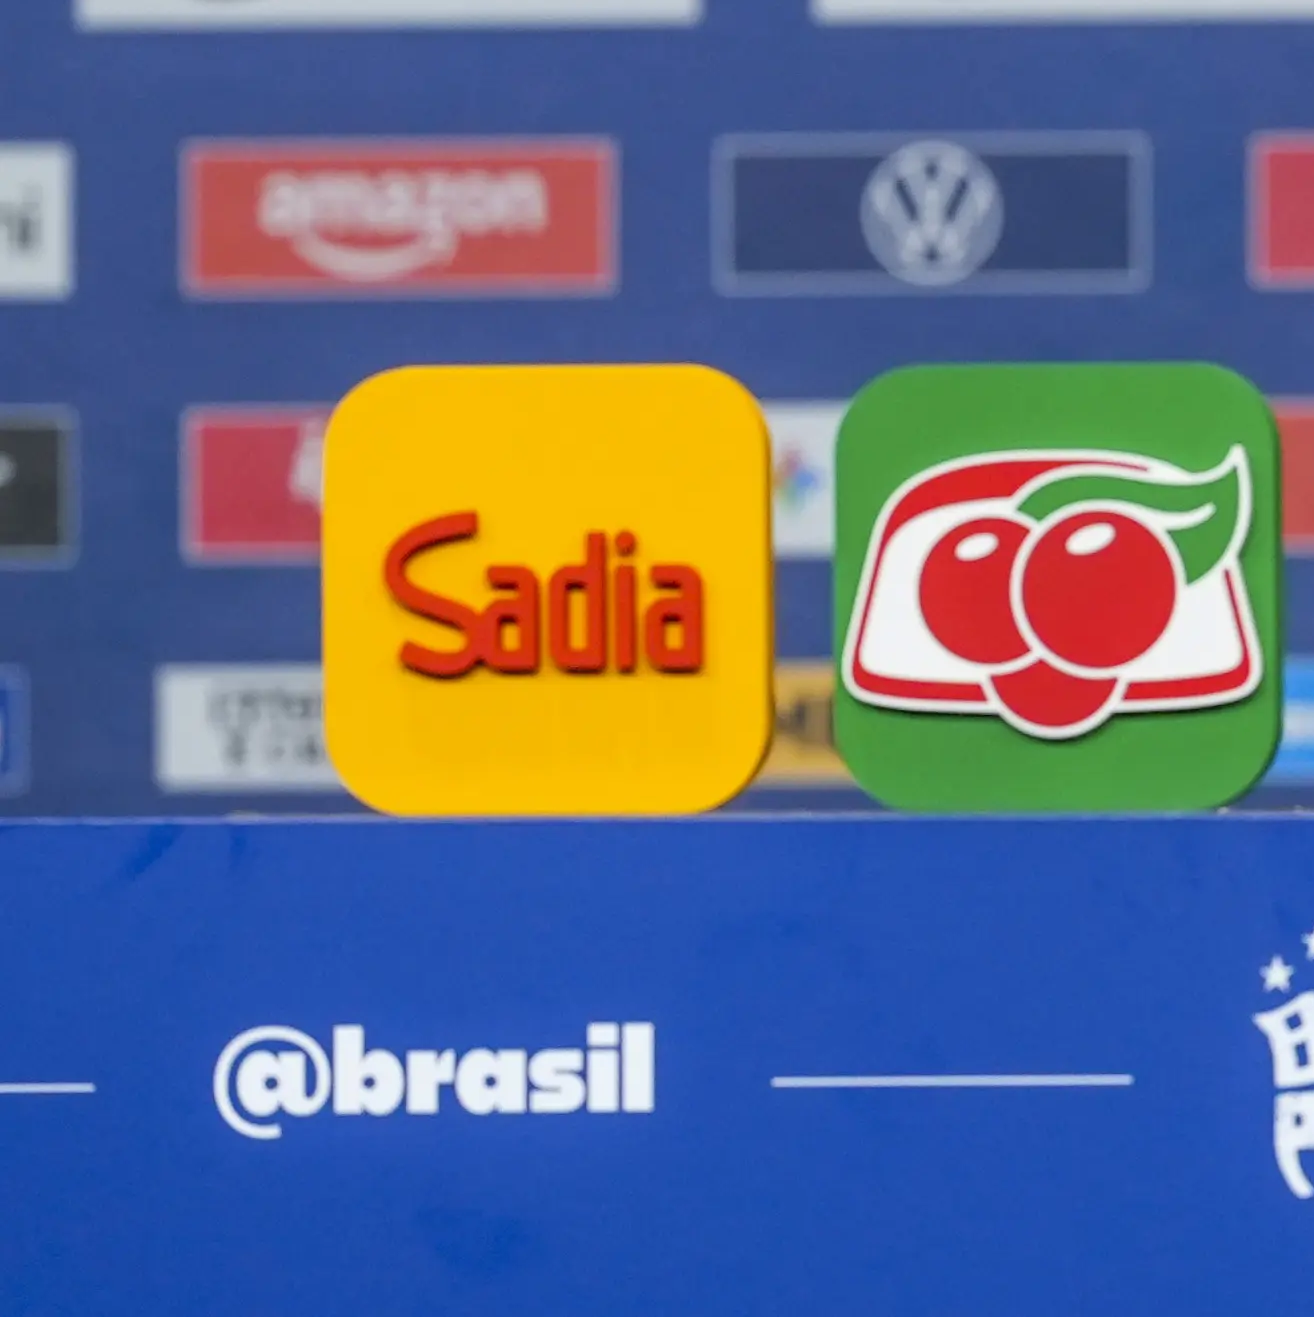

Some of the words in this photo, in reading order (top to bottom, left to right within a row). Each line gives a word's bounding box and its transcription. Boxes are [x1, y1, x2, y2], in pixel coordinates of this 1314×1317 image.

[257, 170, 548, 236] amazon
[384, 512, 705, 683] Sadia
[214, 1023, 654, 1139] @brasil
